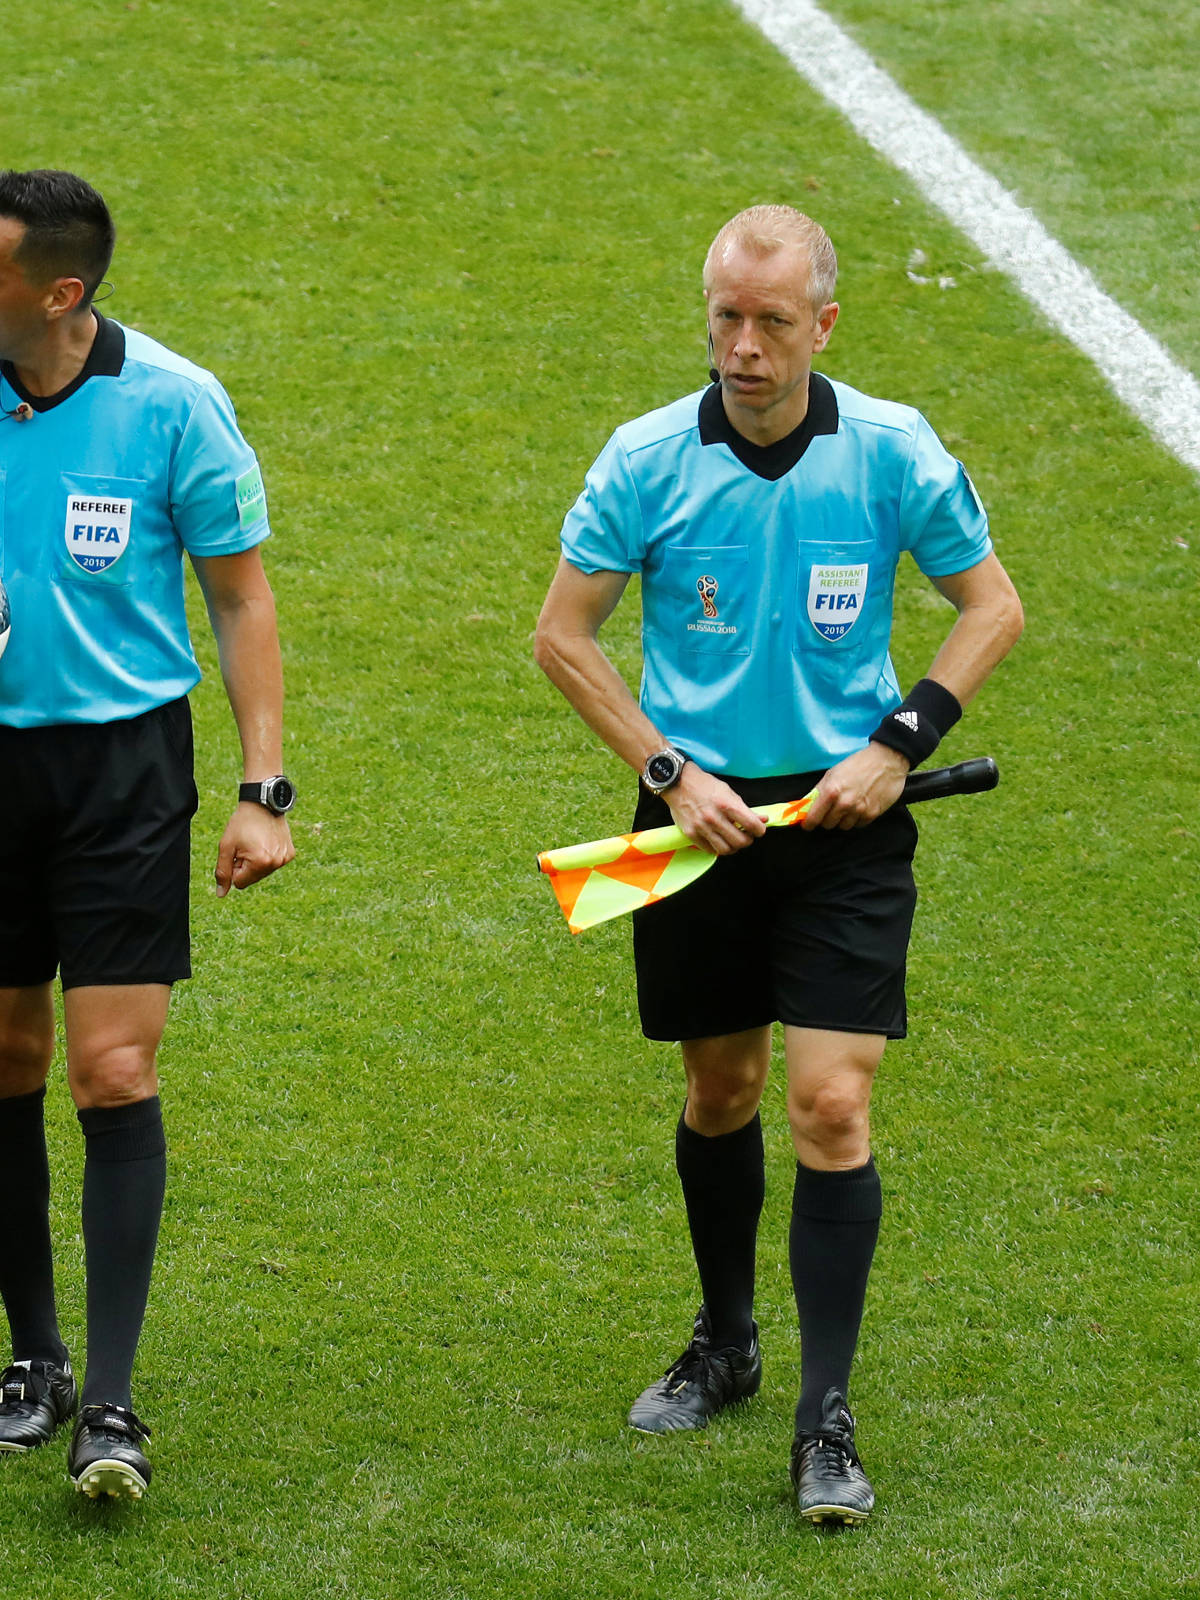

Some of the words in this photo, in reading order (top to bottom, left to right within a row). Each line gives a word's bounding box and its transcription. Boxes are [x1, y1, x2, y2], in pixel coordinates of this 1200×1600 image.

[72, 501, 127, 515] REFEREE
[73, 524, 120, 544] FIFA
[83, 557, 106, 568] 2018
[818, 569, 864, 578] ASSISTANT
[820, 578, 860, 588] REFEREE
[815, 593, 858, 610] FIFA
[687, 623, 716, 633] RUSSIA
[824, 625, 845, 635] 2018
[893, 713, 919, 732] adidas
